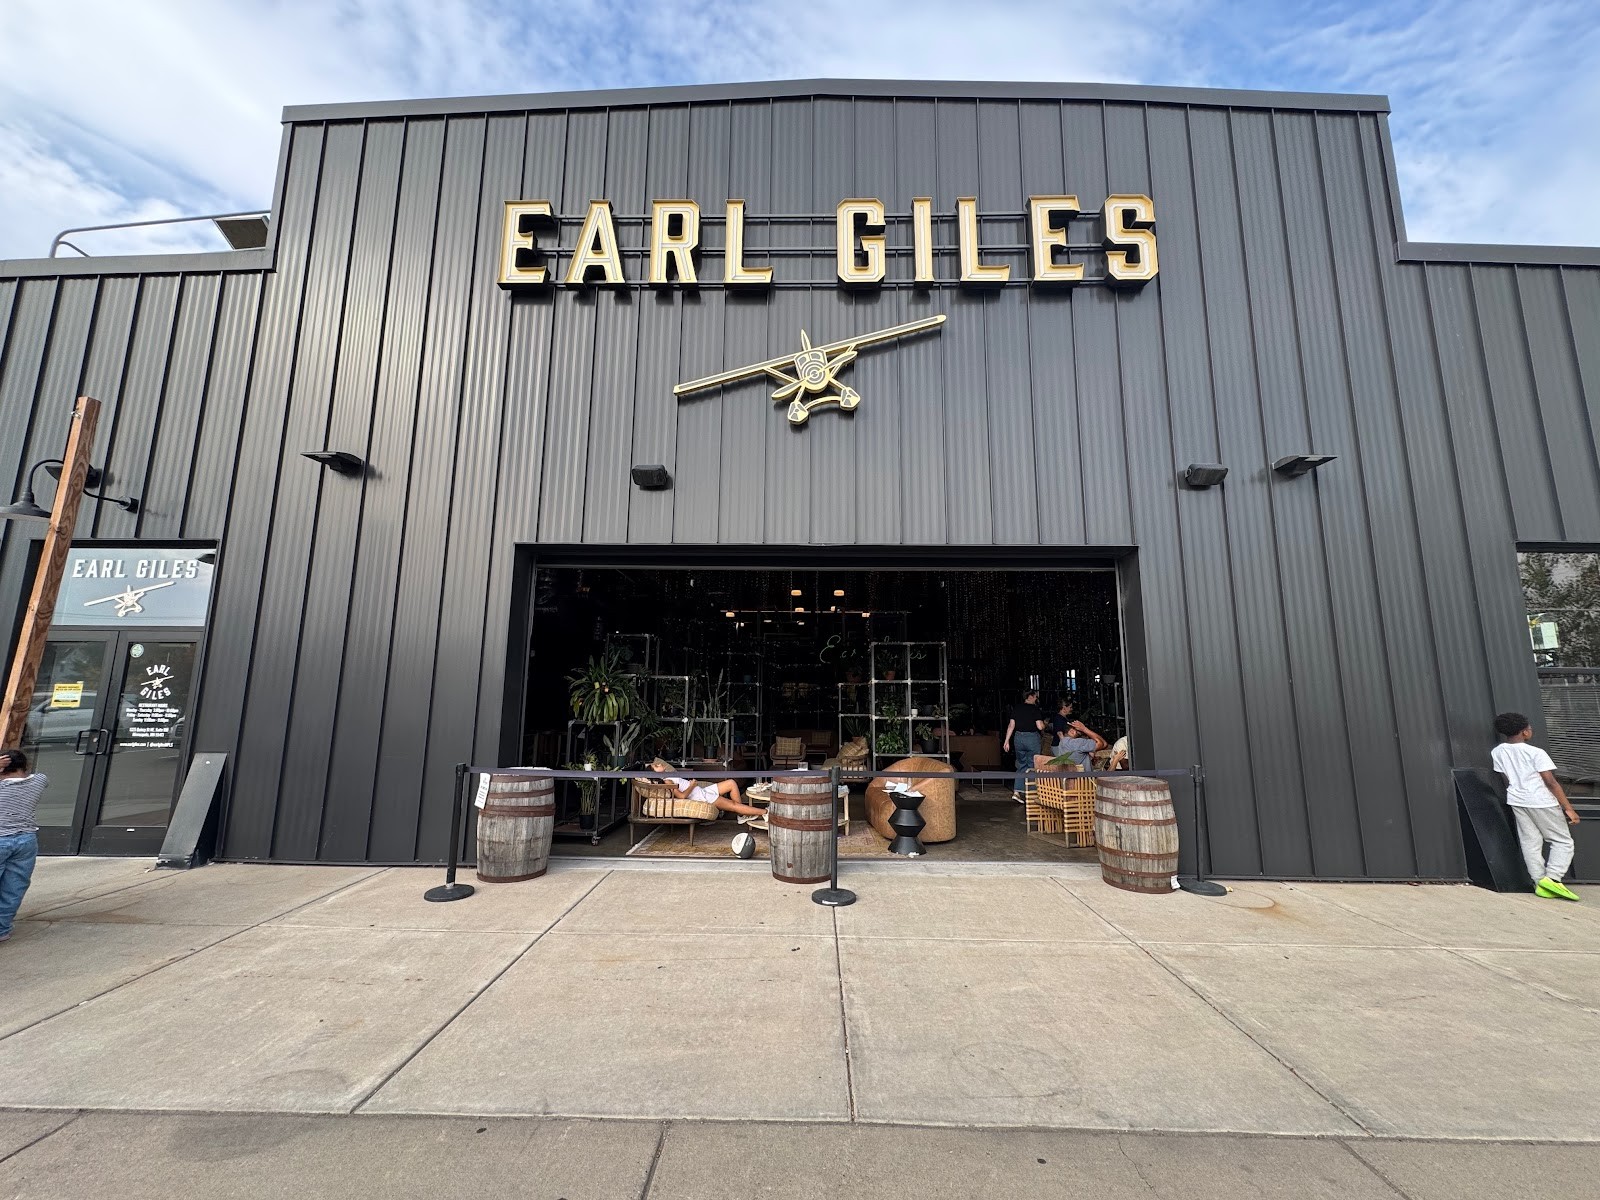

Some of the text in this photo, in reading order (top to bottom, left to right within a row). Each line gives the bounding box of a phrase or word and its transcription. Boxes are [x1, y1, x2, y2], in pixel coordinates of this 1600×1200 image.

[497, 194, 1160, 289] EARL GILES
[72, 558, 200, 579] EARL GILES
[146, 664, 171, 676] EARL
[140, 686, 172, 700] GILES
